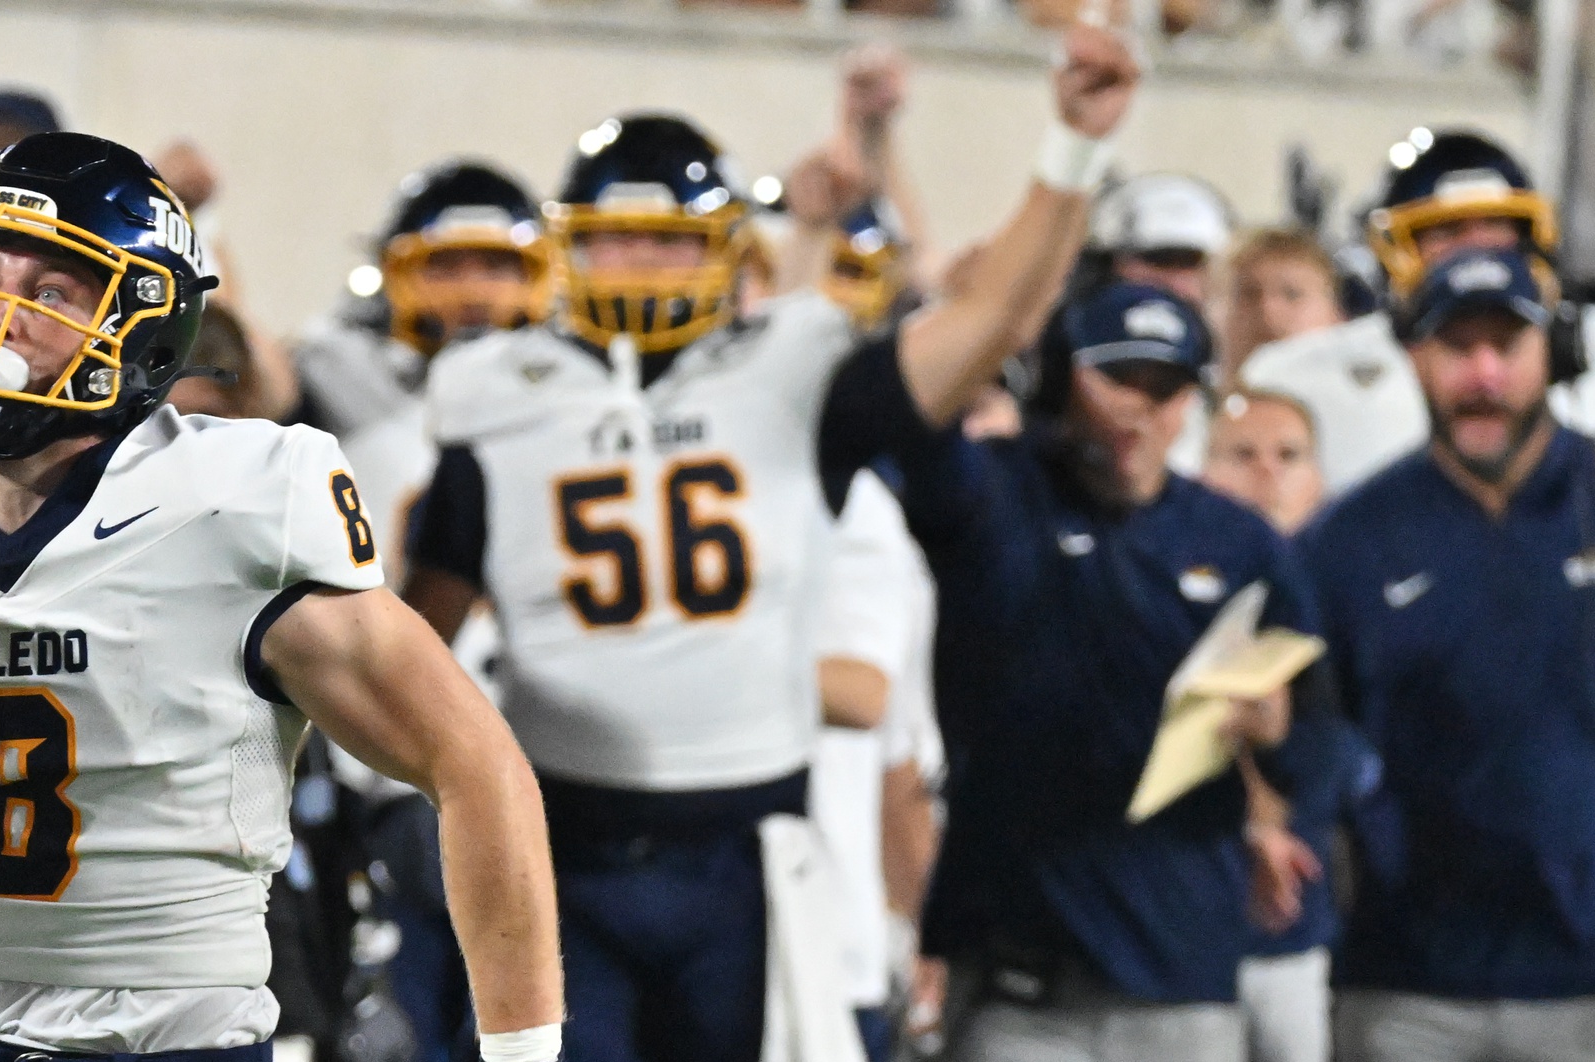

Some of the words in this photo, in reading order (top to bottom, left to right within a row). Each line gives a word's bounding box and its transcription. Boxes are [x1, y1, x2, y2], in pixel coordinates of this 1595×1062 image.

[17, 194, 48, 211] CITY
[328, 468, 378, 569] 8
[554, 459, 749, 631] 56
